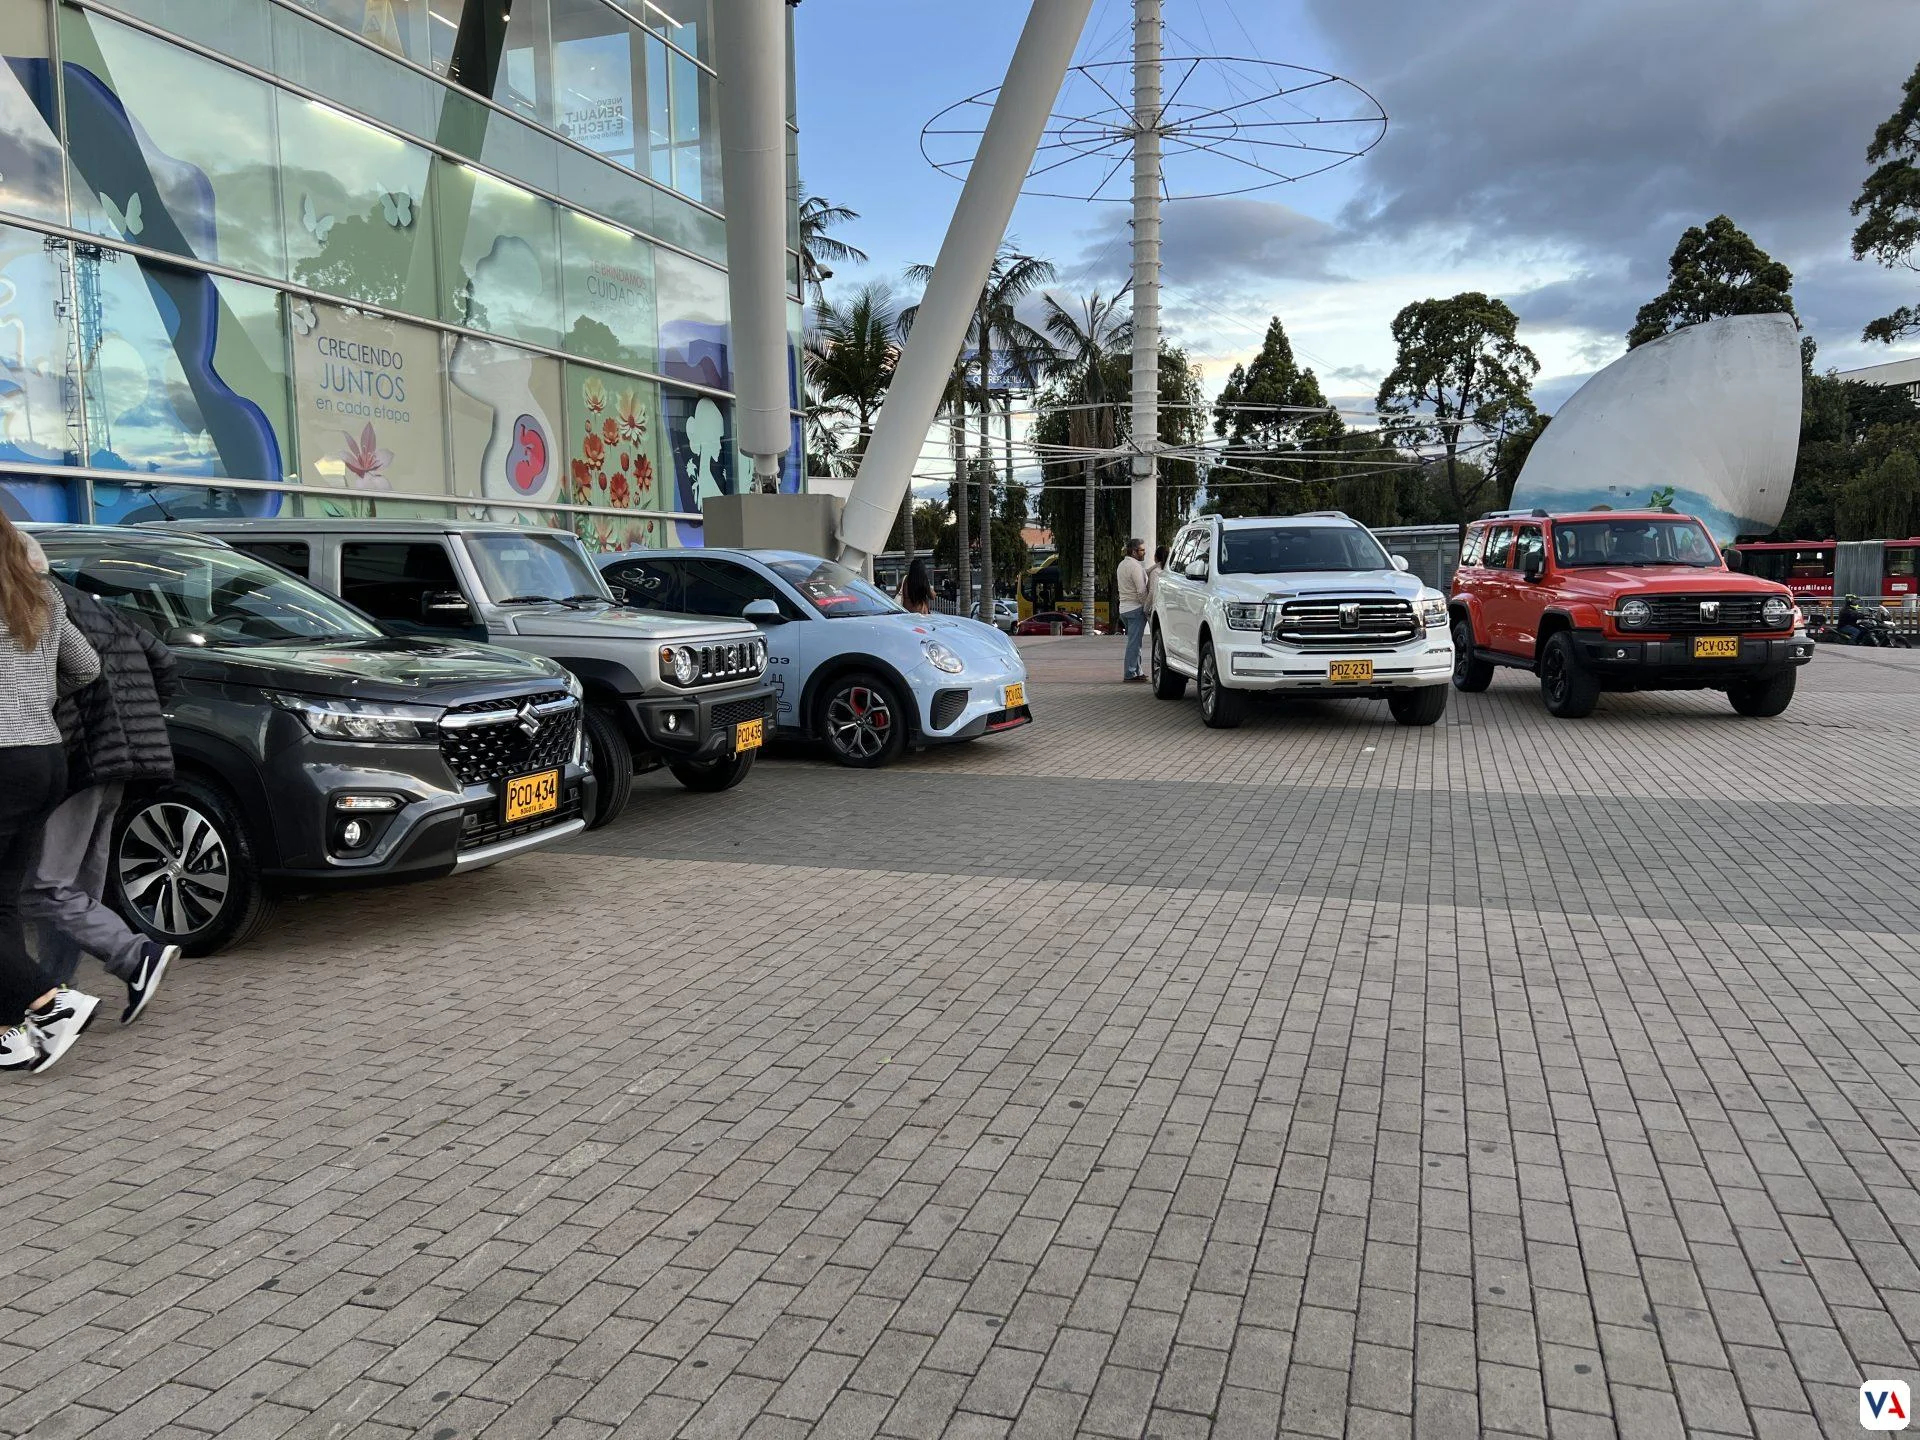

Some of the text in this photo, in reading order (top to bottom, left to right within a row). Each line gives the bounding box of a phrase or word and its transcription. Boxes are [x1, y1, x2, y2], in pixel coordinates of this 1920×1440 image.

[317, 336, 403, 370] CRECIENDO
[319, 362, 405, 402] JUNTOS
[316, 397, 410, 424] en cada etapa
